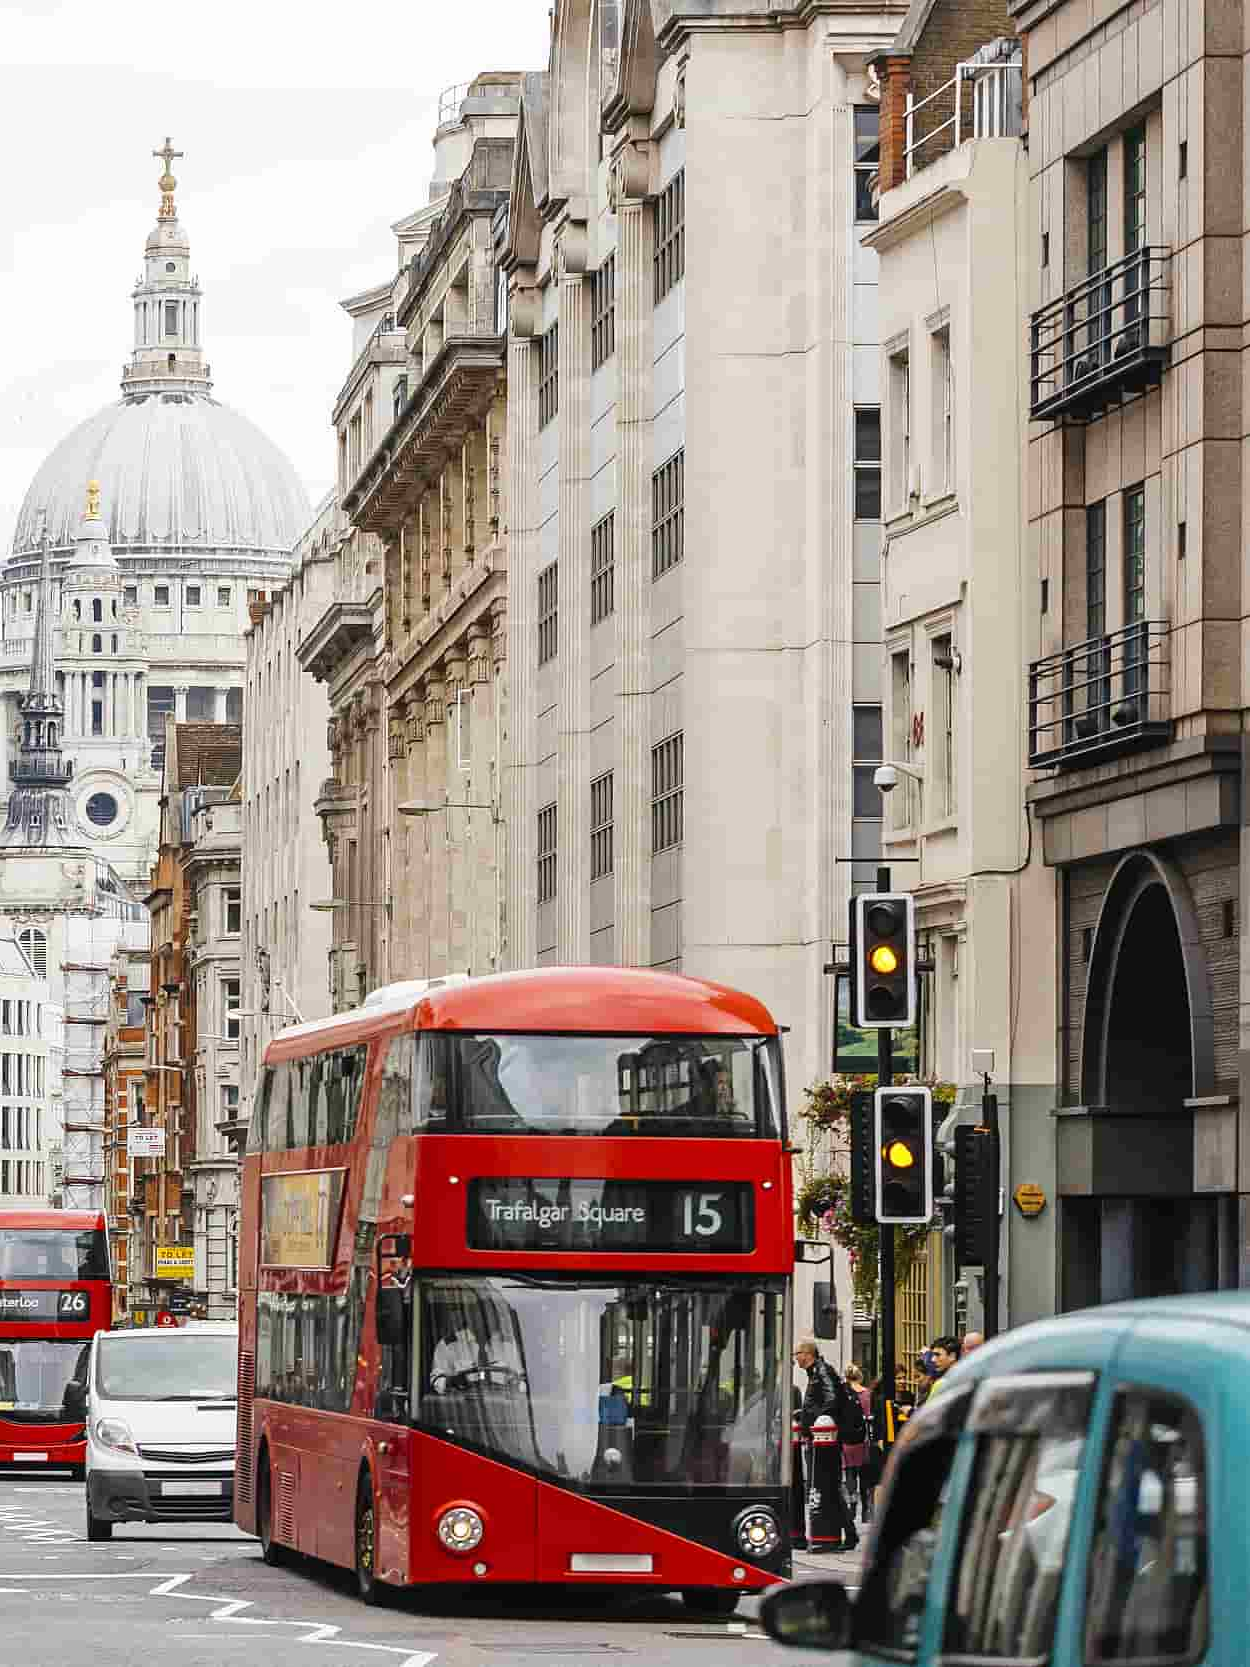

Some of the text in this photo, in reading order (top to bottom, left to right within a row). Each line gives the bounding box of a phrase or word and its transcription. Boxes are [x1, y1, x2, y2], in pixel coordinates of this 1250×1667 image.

[485, 1193, 723, 1236] Trafalgar Square 15
[61, 1293, 85, 1311] 26
